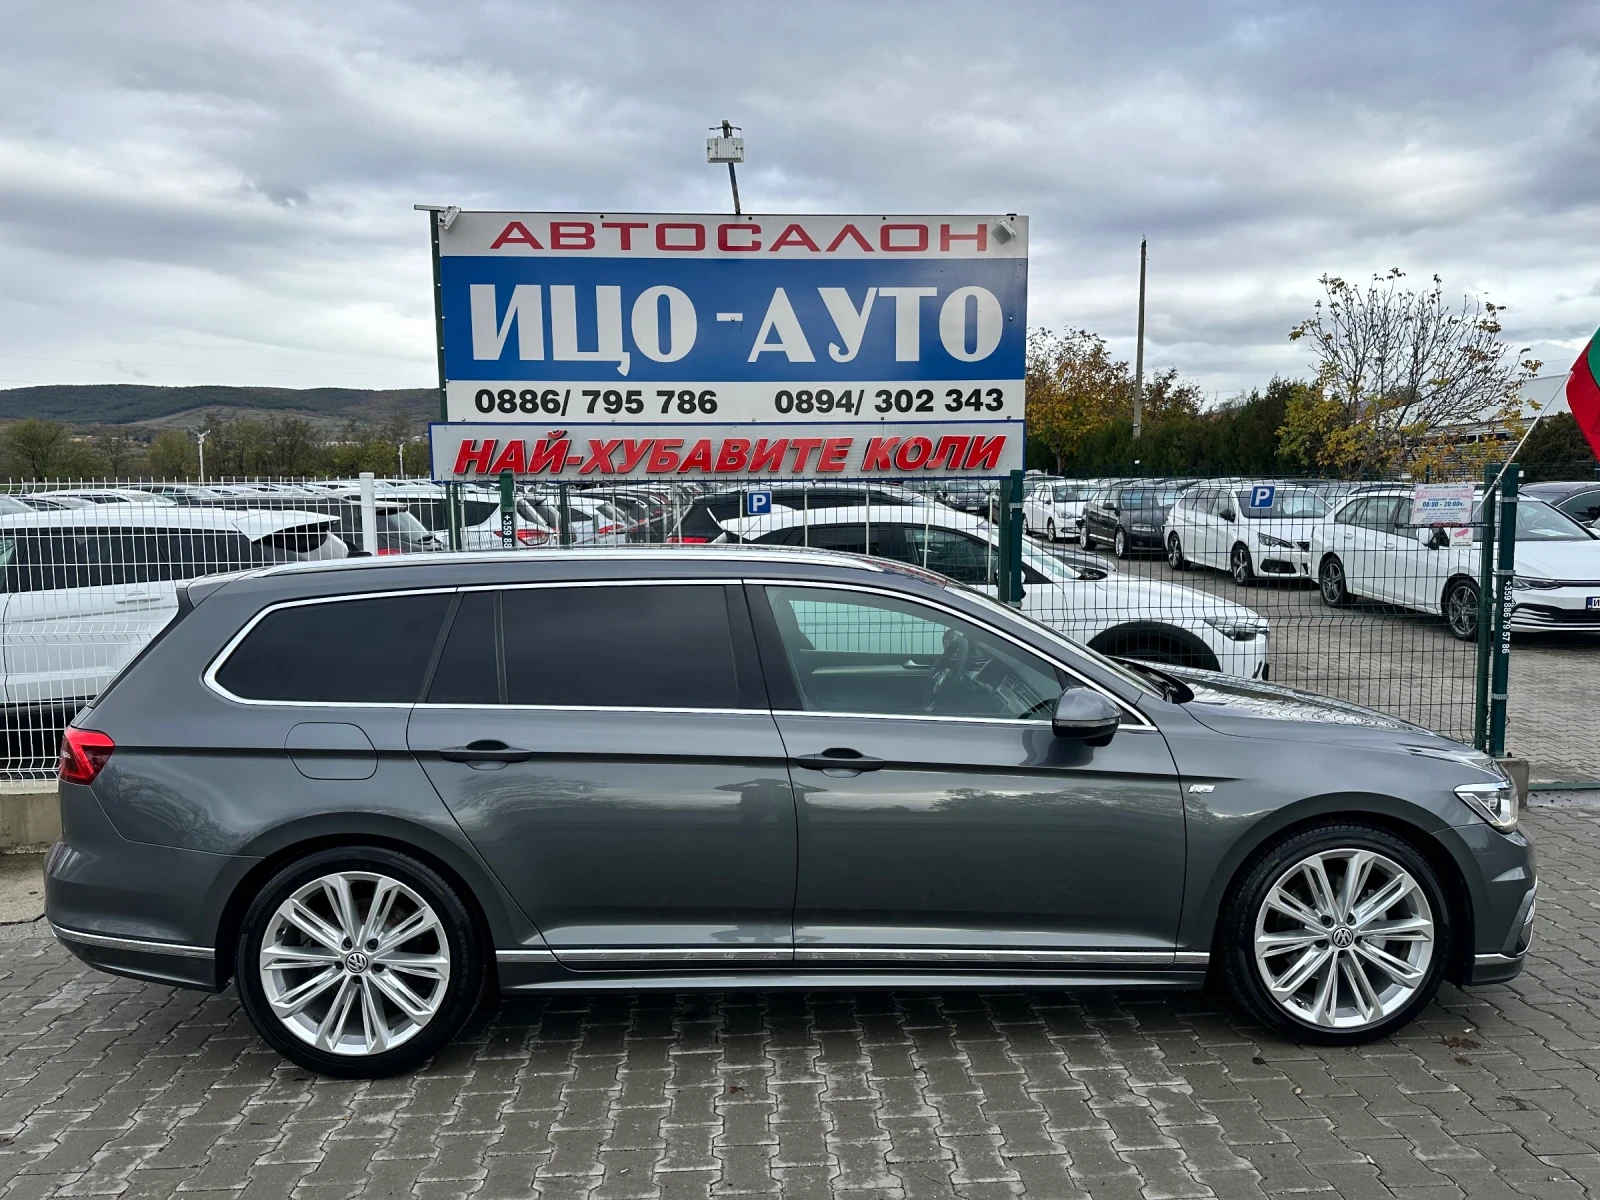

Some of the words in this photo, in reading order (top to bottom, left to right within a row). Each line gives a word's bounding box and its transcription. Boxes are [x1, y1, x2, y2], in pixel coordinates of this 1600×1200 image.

[490, 222, 986, 252] АВТОСАЛОН
[475, 389, 570, 416] 0886/
[582, 389, 644, 415] 795
[656, 390, 718, 415] 786
[775, 389, 864, 416] 0894/
[874, 389, 934, 412] 302
[944, 389, 1004, 412] 343
[453, 430, 853, 474] НАЙ-ХУБАВИТЕ
[861, 435, 1007, 471] КОЛИ
[752, 494, 767, 511] P
[1255, 488, 1270, 505] P
[502, 514, 513, 536] +359
[1503, 580, 1513, 601] +359
[1503, 602, 1512, 618] 886
[1502, 619, 1511, 630] 79
[1502, 631, 1511, 642] 57
[1501, 643, 1510, 654] 86
